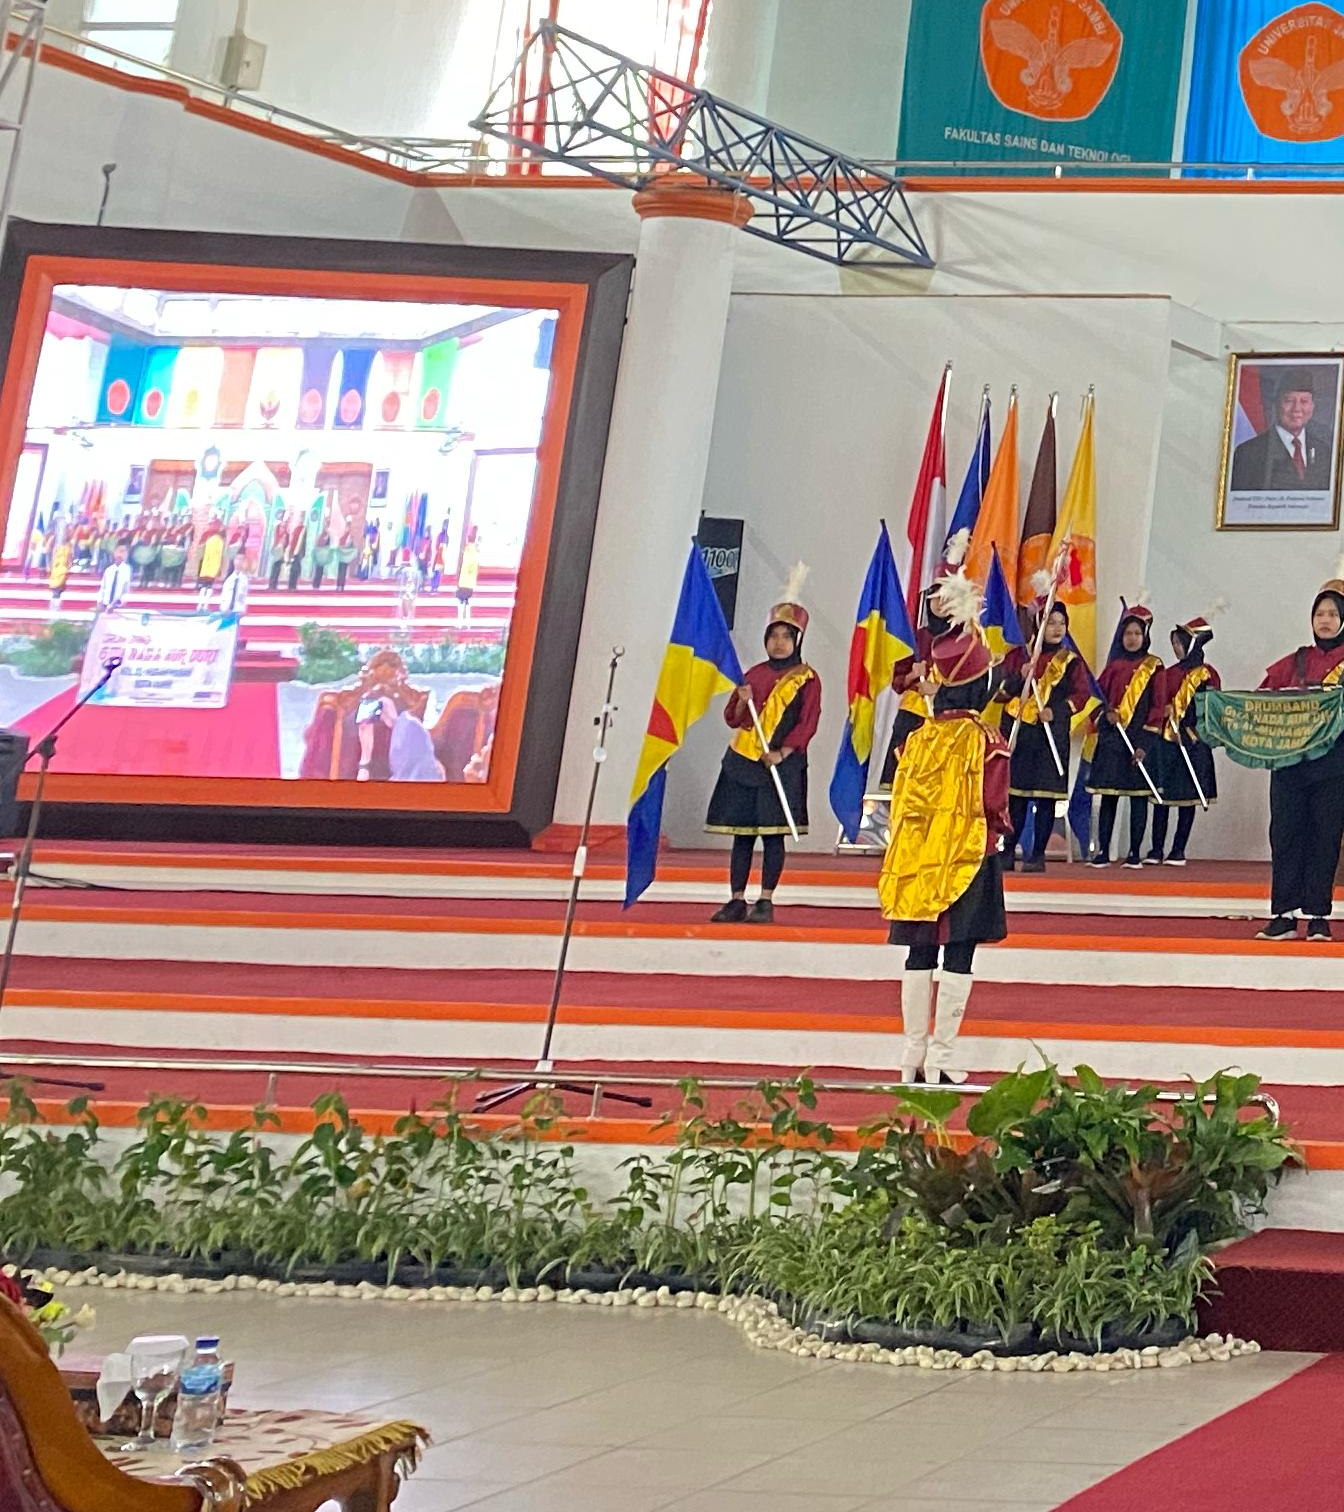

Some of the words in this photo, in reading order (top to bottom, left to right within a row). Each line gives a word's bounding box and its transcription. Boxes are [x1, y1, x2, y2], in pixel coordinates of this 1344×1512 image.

[944, 127, 1001, 146] FAKULTAS
[1004, 134, 1038, 151] SAINS
[1040, 140, 1065, 156] DAN
[1244, 699, 1320, 713] DRUMBAND
